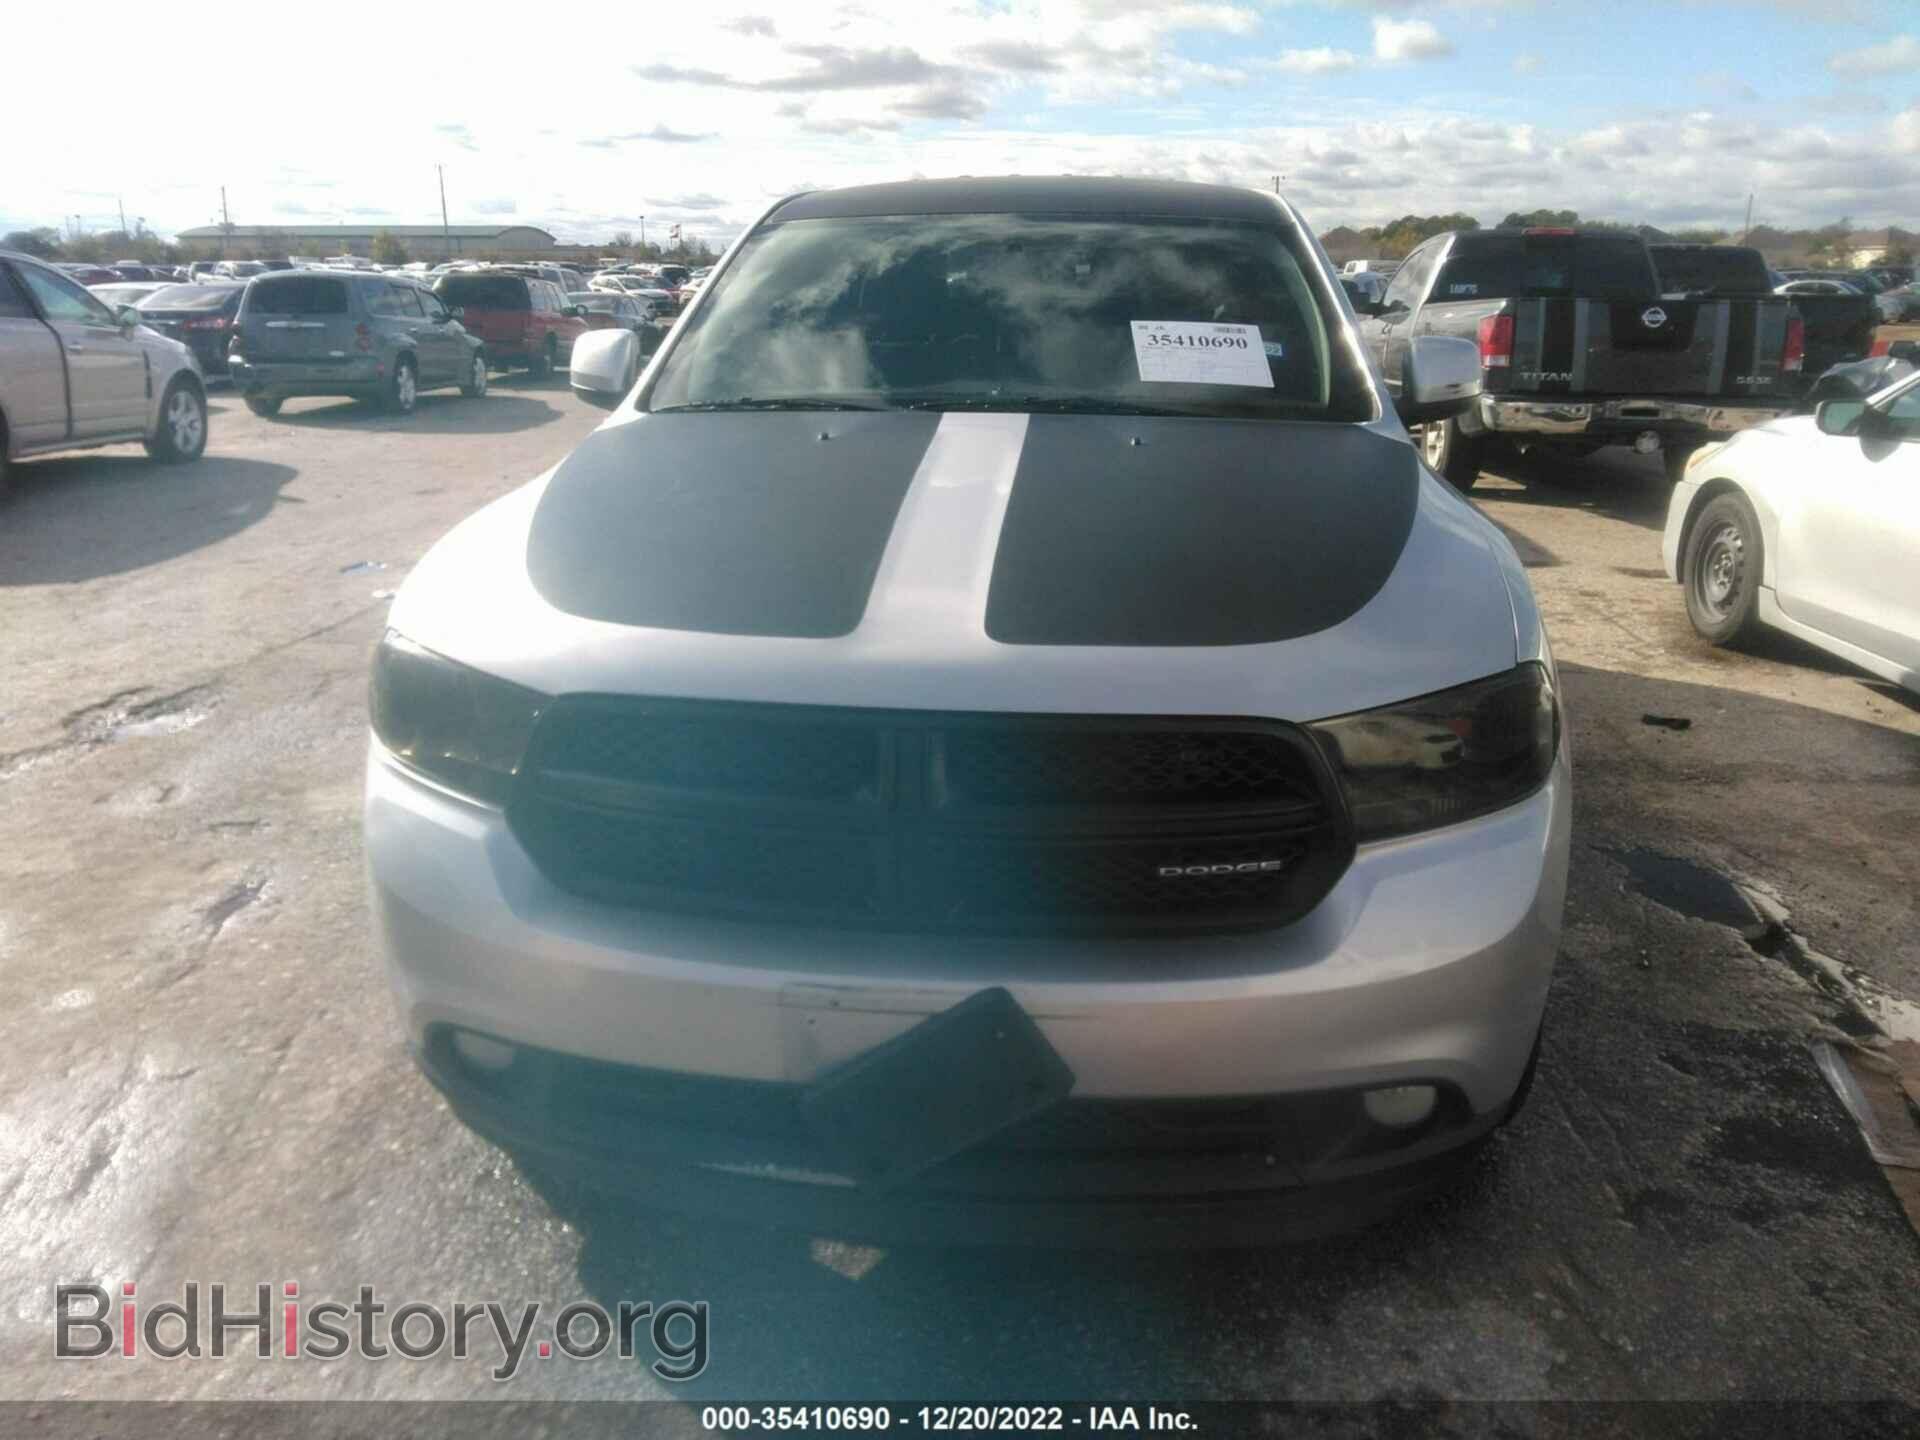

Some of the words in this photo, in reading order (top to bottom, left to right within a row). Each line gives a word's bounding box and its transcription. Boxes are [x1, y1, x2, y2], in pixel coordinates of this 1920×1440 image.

[1147, 334, 1248, 349] 35410690
[1519, 371, 1574, 381] TITAN
[1159, 860, 1281, 876] DODGE
